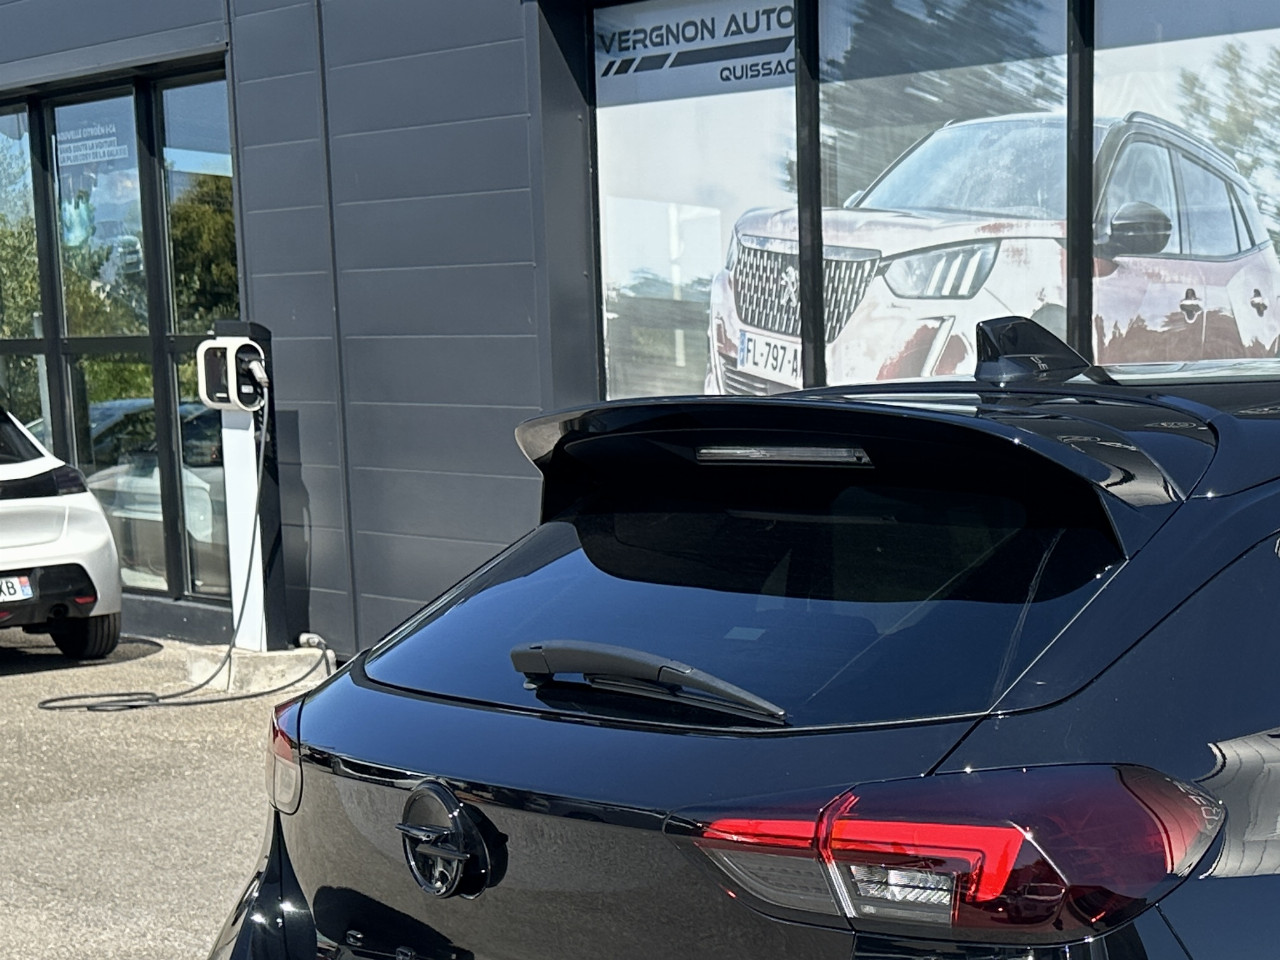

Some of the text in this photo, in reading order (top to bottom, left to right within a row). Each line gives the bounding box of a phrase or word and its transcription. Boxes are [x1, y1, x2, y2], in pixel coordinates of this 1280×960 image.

[597, 5, 795, 54] VERGNON AUTO
[720, 58, 795, 82] QUISSAC
